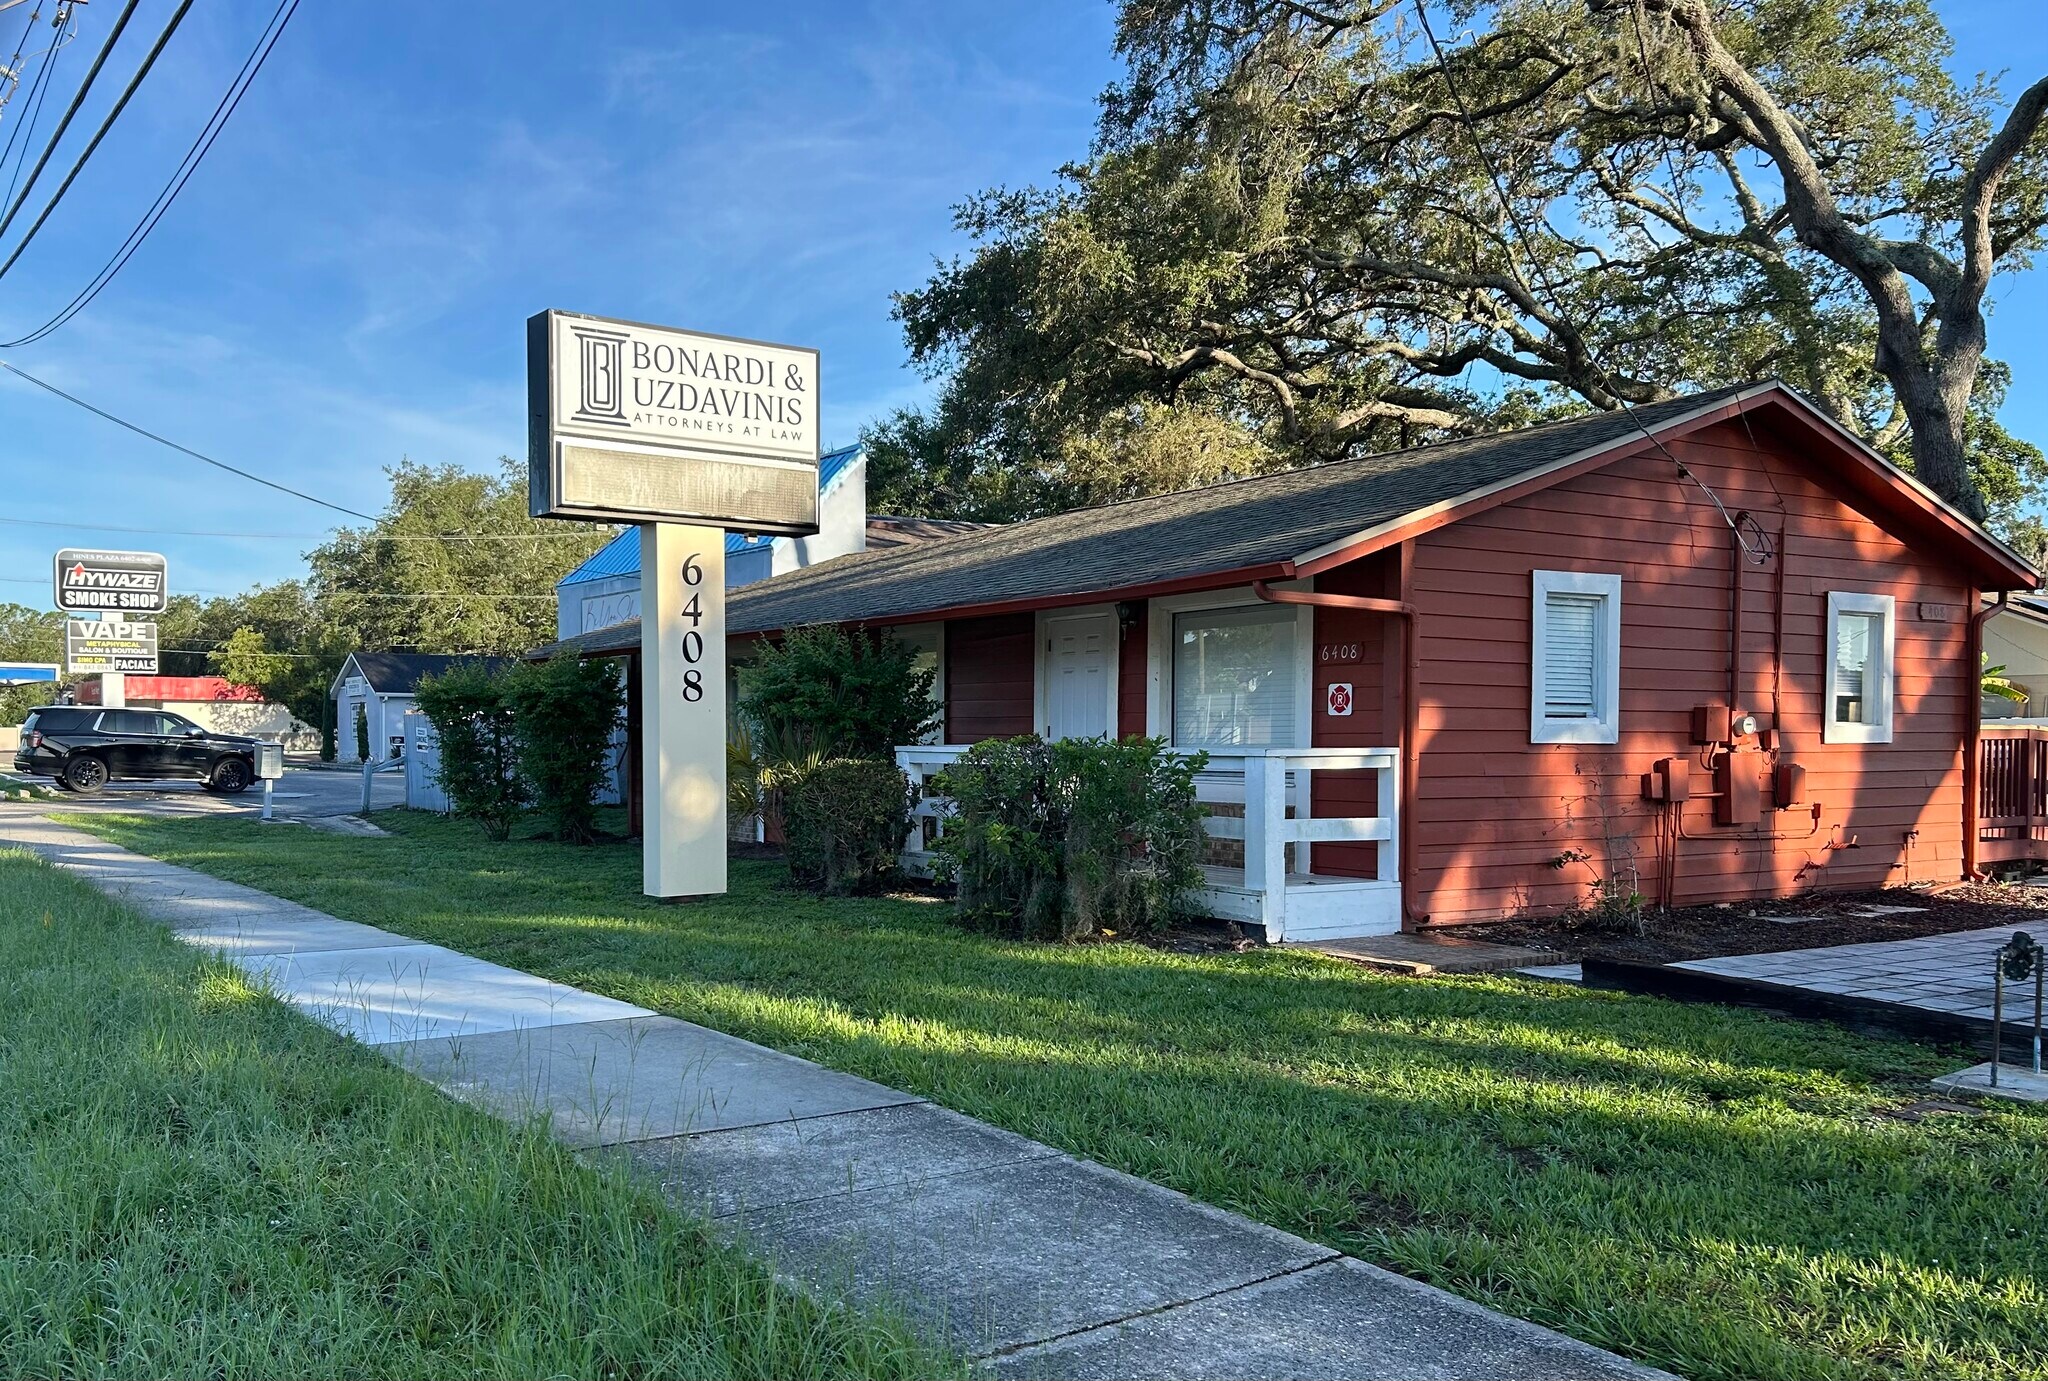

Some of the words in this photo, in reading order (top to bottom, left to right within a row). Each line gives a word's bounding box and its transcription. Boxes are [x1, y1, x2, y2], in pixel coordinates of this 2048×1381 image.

[632, 340, 775, 387] BONARDI
[784, 363, 806, 392] &
[632, 376, 803, 426] UZDAVINIS
[634, 412, 734, 434] ATTORNEYS
[743, 426, 760, 437] AT
[771, 426, 803, 441] LAW
[68, 570, 158, 589] HYWAZE
[65, 590, 118, 606] SMOKE
[119, 592, 159, 608] SHOP
[78, 621, 147, 639] VAPE
[681, 552, 704, 703] 6408
[86, 640, 141, 648] METAPHYSICAL
[1321, 644, 1358, 661] 6408
[115, 659, 157, 671] FACIALS
[1337, 694, 1343, 705] R
